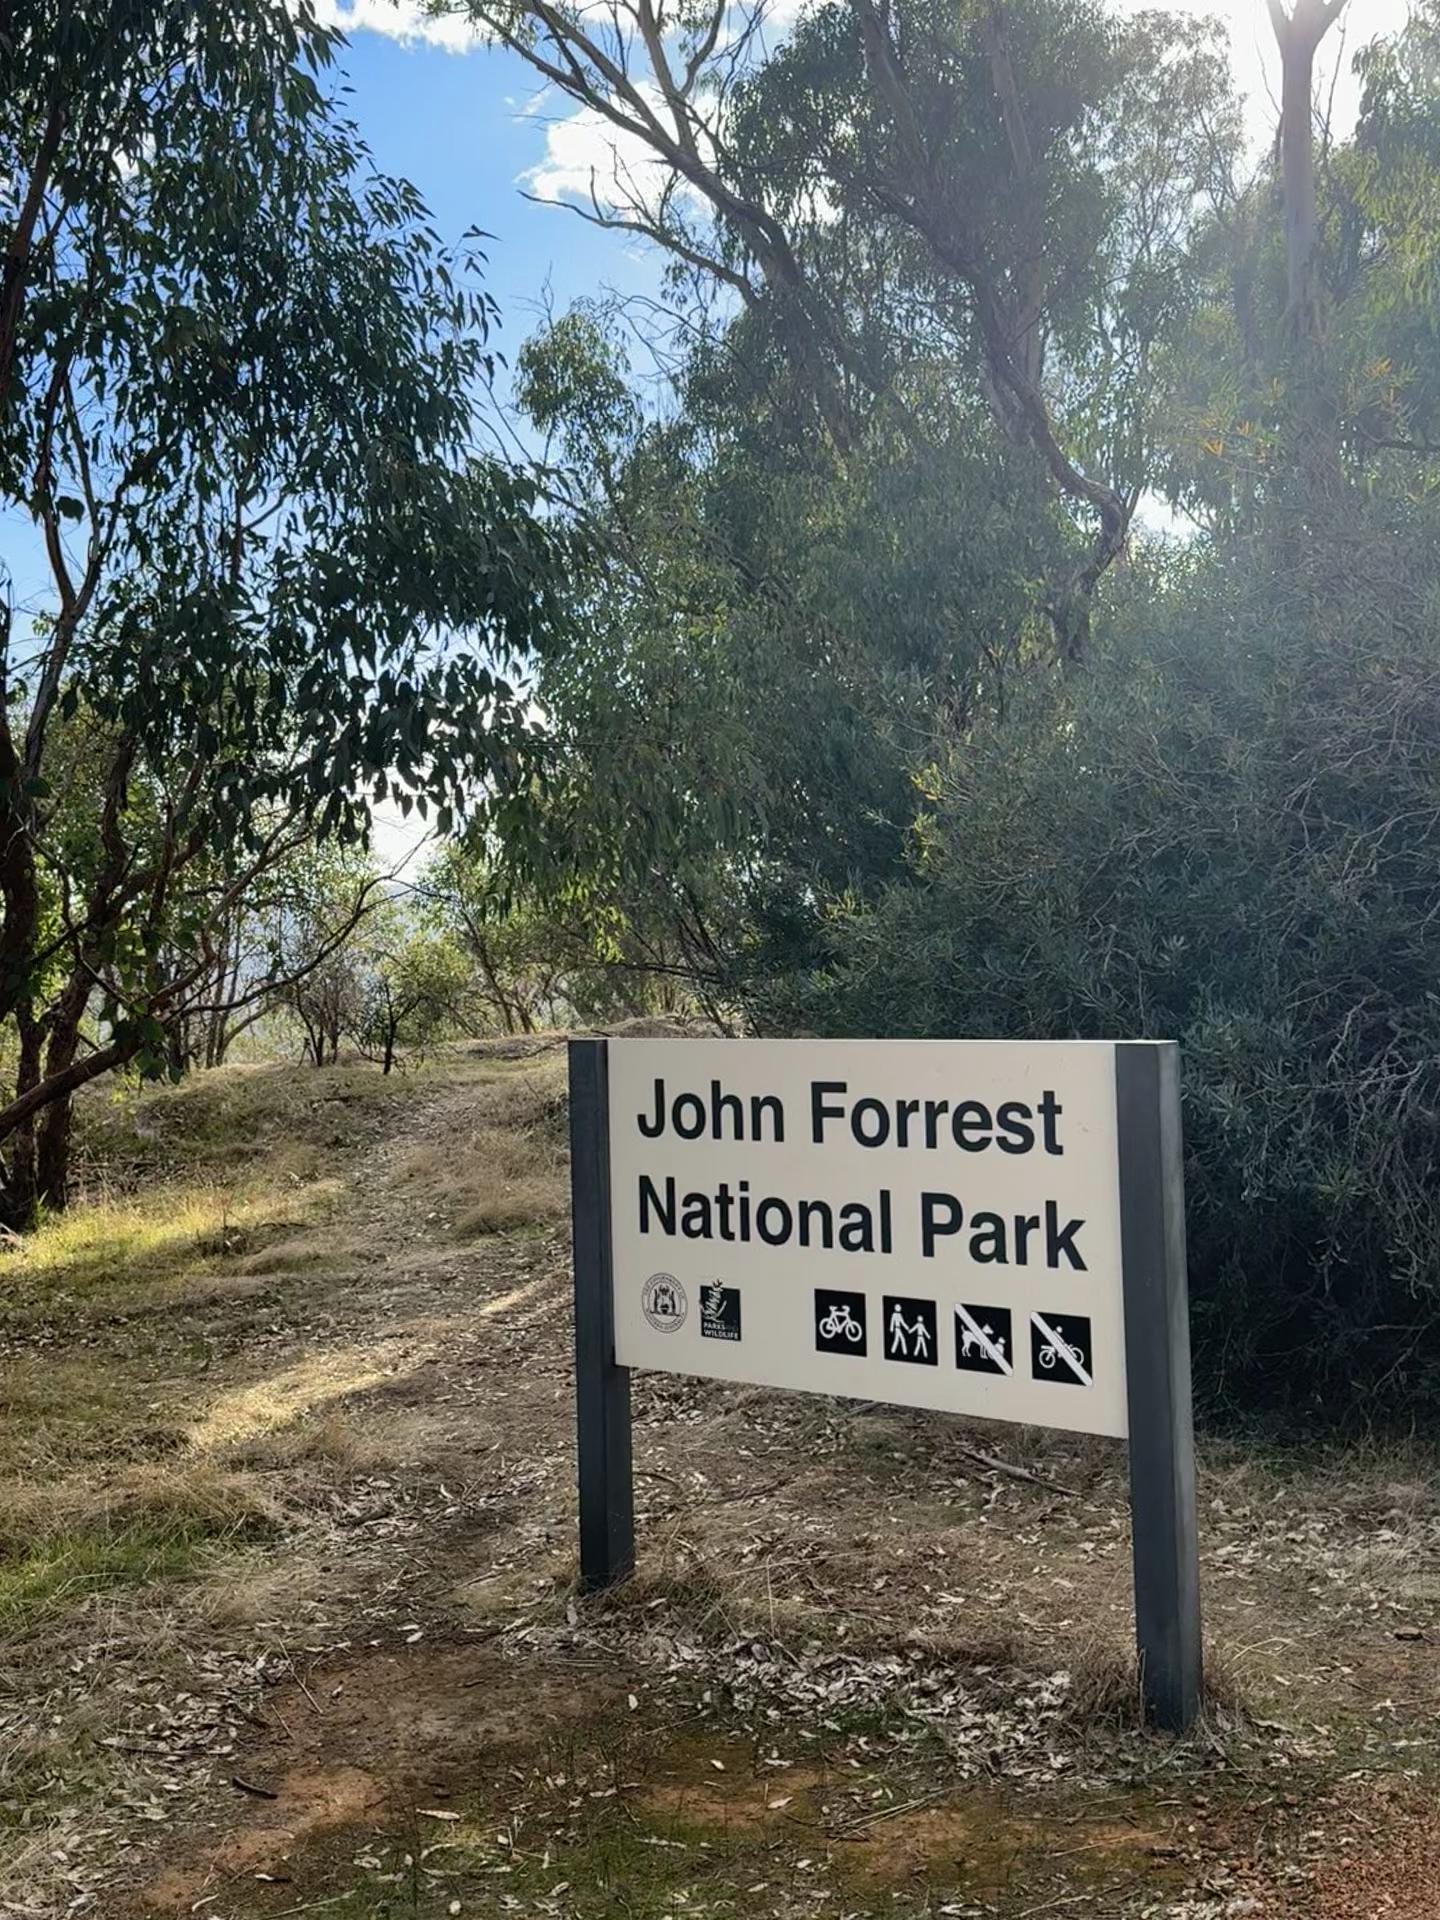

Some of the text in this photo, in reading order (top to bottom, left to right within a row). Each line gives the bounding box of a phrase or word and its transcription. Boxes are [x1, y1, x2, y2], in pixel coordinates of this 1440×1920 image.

[637, 1079, 1063, 1155] John Forrest
[639, 1175, 1087, 1271] National Park
[703, 1322, 726, 1330] PARKS
[704, 1329, 738, 1339] WILDLIFE
